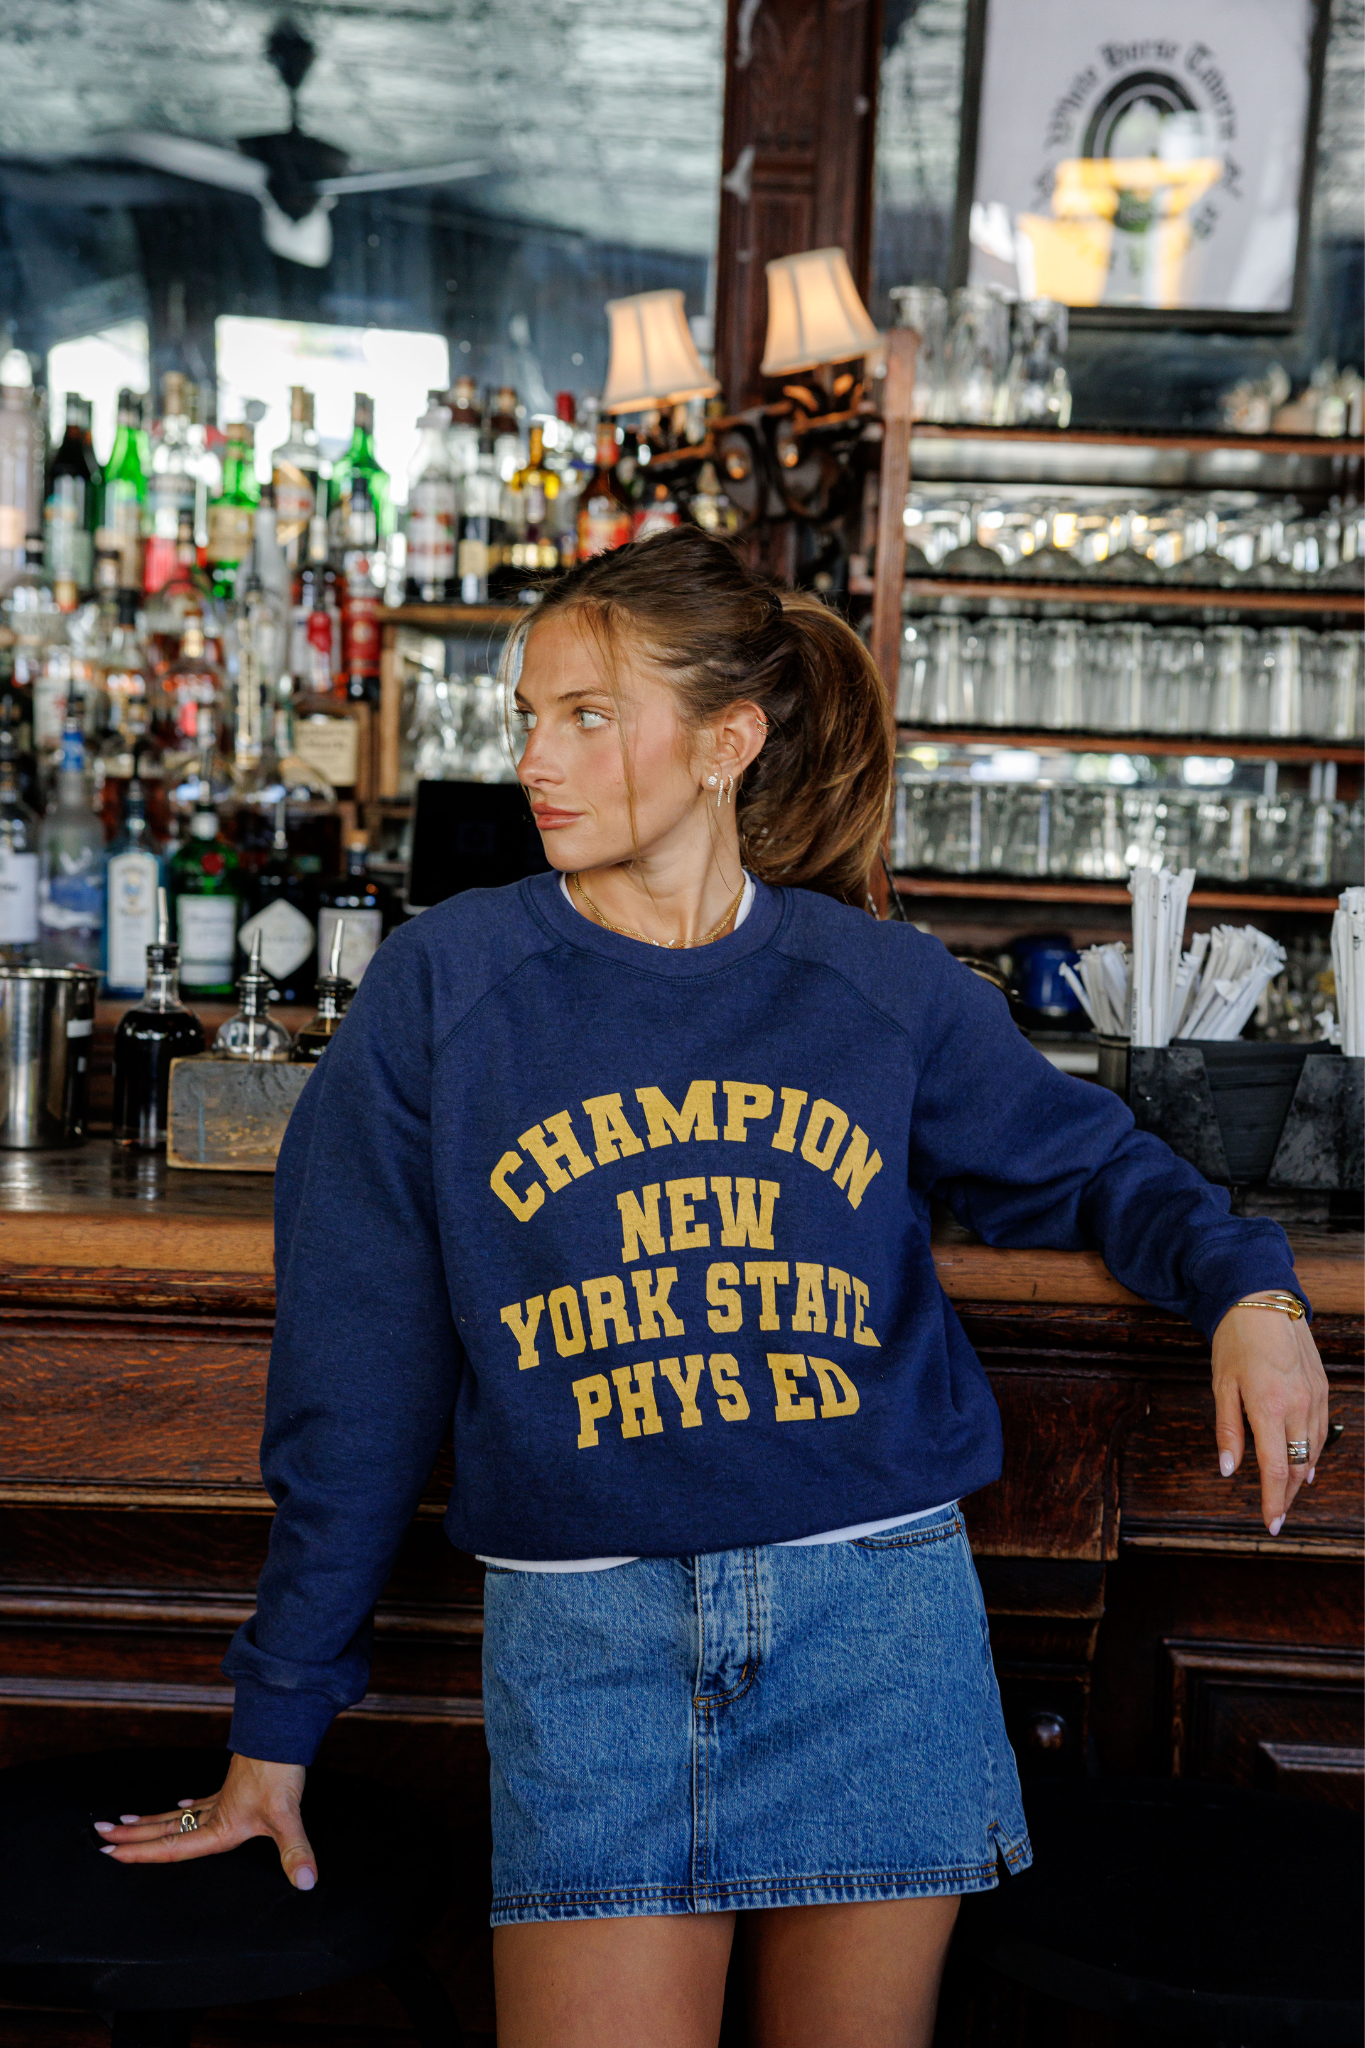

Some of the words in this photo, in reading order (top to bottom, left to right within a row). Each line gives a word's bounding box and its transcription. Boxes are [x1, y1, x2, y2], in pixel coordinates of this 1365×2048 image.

[489, 1080, 883, 1223] CHAMPION
[616, 1176, 780, 1263] NEW
[500, 1266, 685, 1371] YORK
[706, 1261, 881, 1347] STATE
[572, 1353, 751, 1449] PHYS
[766, 1353, 860, 1422] ED
